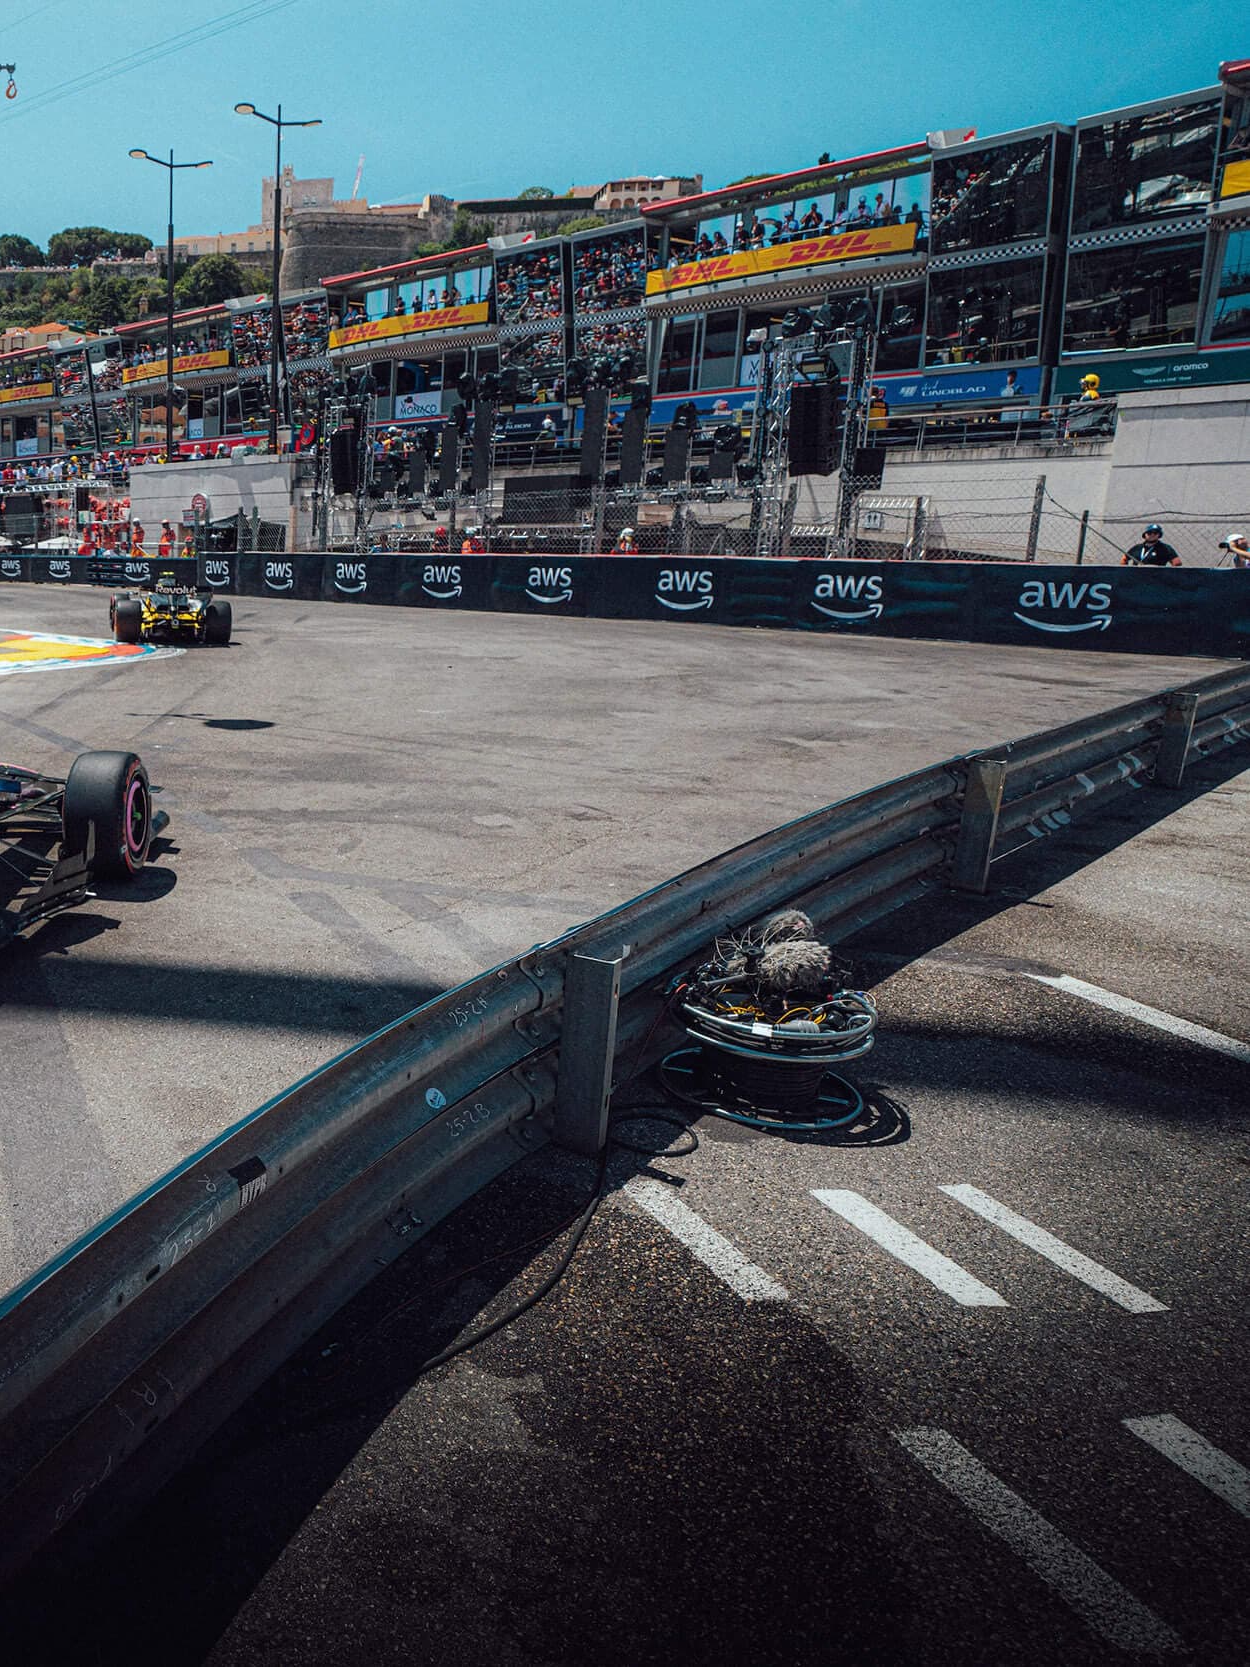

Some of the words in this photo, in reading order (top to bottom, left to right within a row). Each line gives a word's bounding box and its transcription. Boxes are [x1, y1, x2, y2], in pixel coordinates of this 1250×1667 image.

[789, 233, 875, 264] DHL
[670, 258, 736, 283] DHL
[413, 309, 464, 329] DHL
[343, 322, 382, 342] DHL
[1173, 362, 1209, 372] aramco
[921, 386, 987, 397] LINDBLAD
[400, 404, 438, 416] MONACO
[155, 583, 198, 595] Revolut
